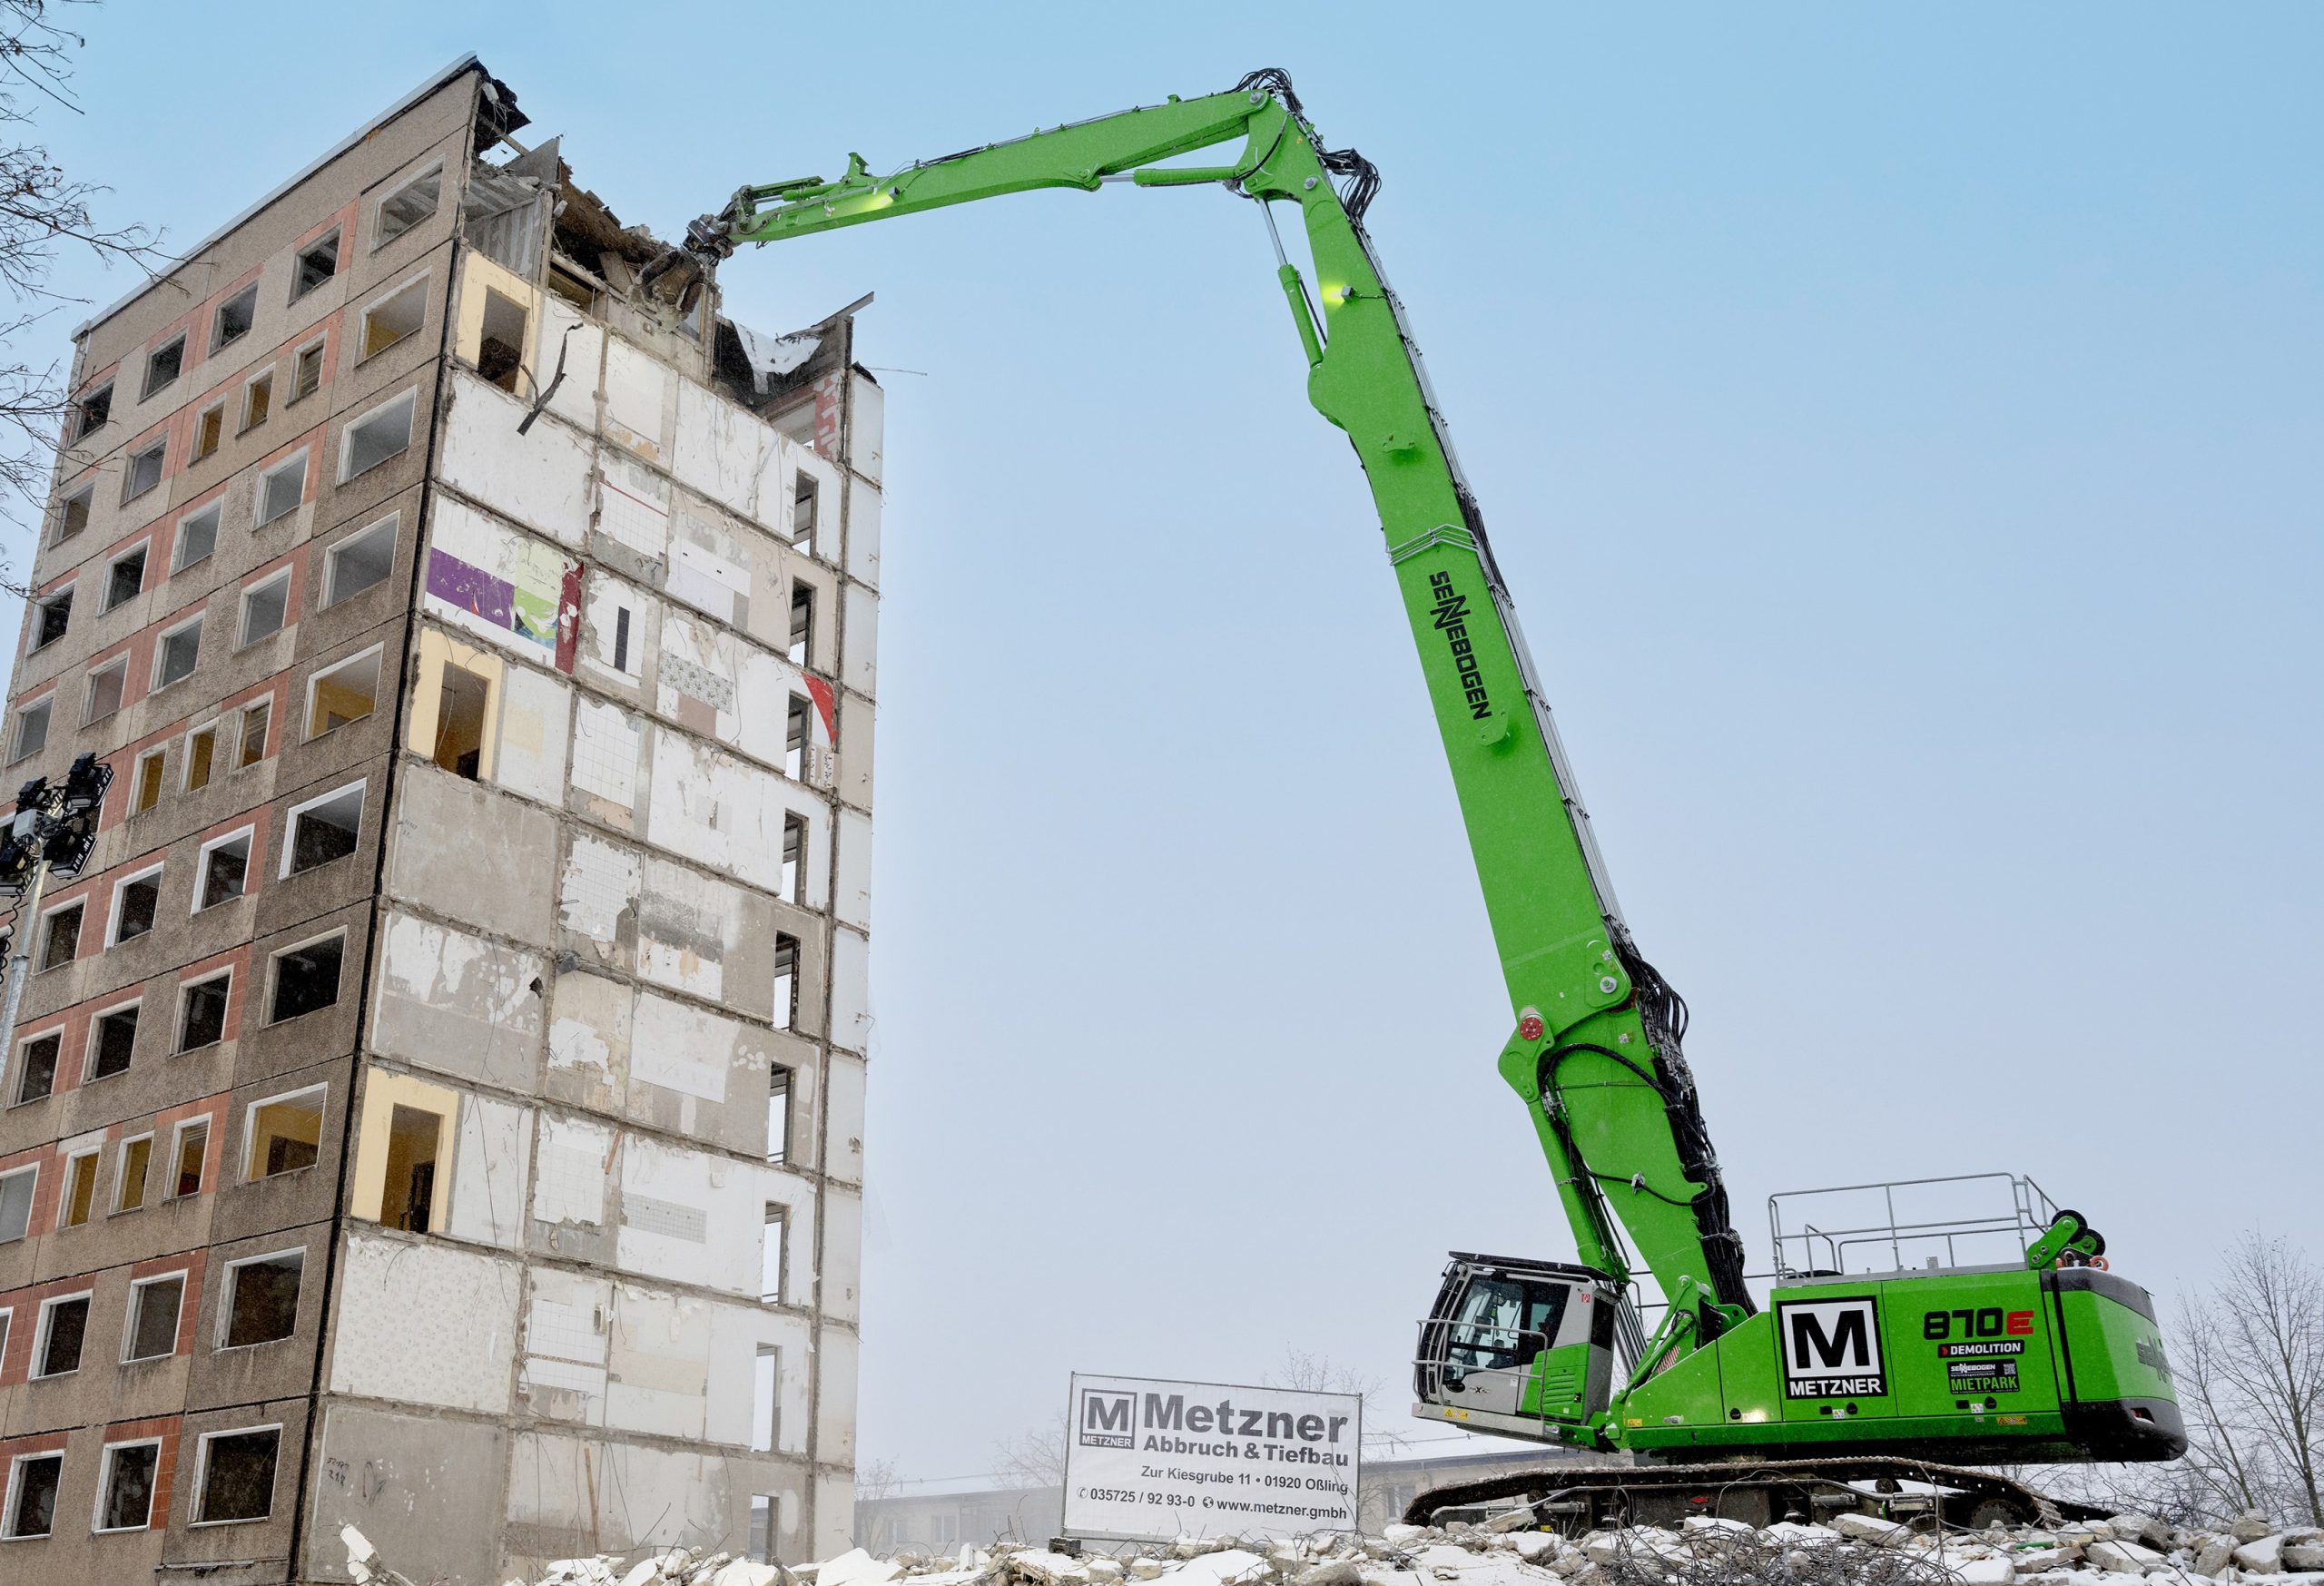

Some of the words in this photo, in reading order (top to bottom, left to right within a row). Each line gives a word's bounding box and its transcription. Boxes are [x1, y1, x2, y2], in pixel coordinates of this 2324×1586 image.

[1429, 570, 1492, 720] SENNEBOGEN
[1791, 1310, 1870, 1369] M
[1950, 1343, 2021, 1355] DEMOLITION
[1951, 1363, 1995, 1374] SENNEBOGEN
[1951, 1376, 2017, 1391] MIETPARK
[1789, 1378, 1882, 1395] METZNER
[1088, 1396, 1129, 1432] M
[1144, 1393, 1348, 1443] Metzner
[1082, 1435, 1132, 1447] METZNER
[1144, 1434, 1237, 1458] Abbruch
[1244, 1443, 1260, 1459] &
[1264, 1443, 1348, 1466] Tiefbau
[1141, 1465, 1163, 1478] Zur
[1167, 1467, 1234, 1483] Kiesgrube
[1238, 1473, 1250, 1484] 11
[1265, 1475, 1301, 1489] 01920
[1305, 1478, 1348, 1495] Oßling
[1090, 1488, 1136, 1502] 035725
[1138, 1492, 1144, 1503] /
[1147, 1492, 1162, 1504] 92
[1167, 1494, 1195, 1507] 93-0
[1216, 1500, 1347, 1520] www.metzner.gmbh
